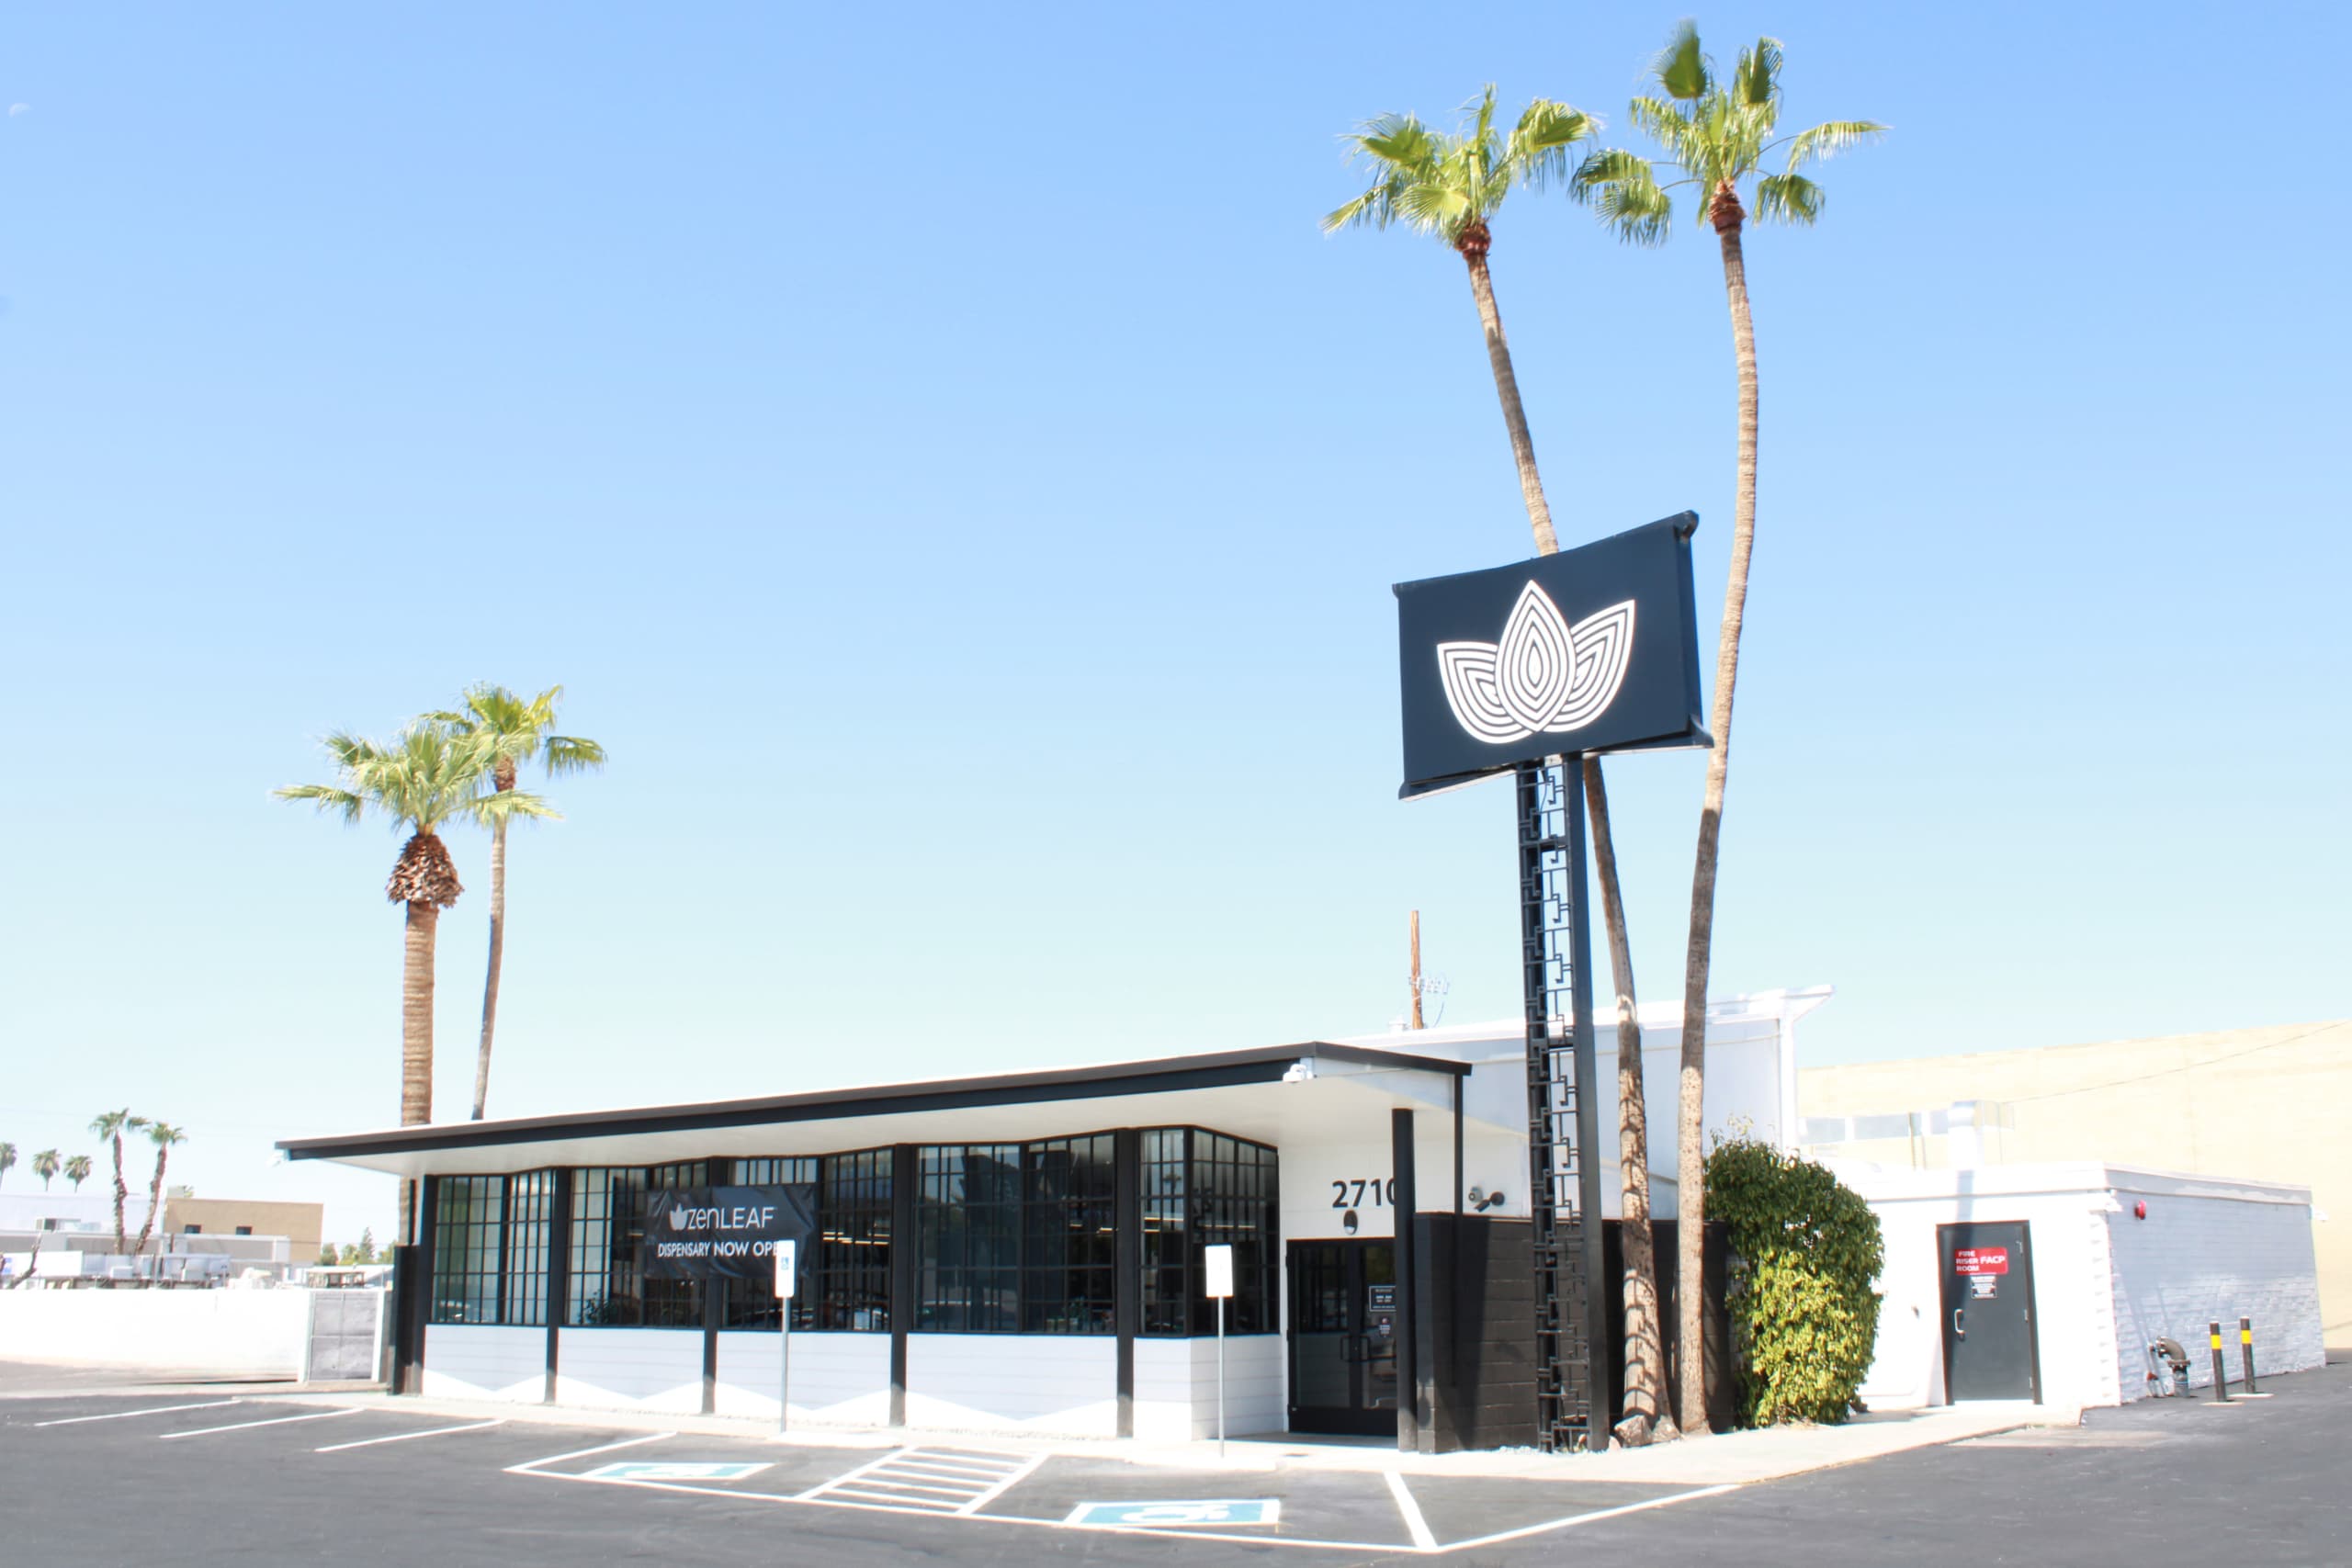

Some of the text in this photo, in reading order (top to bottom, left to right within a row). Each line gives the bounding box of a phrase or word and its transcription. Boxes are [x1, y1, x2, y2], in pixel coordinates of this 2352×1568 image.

[658, 1241, 779, 1258] DISPENSARY NOW OPE
[1980, 1255, 2006, 1265] FACP
